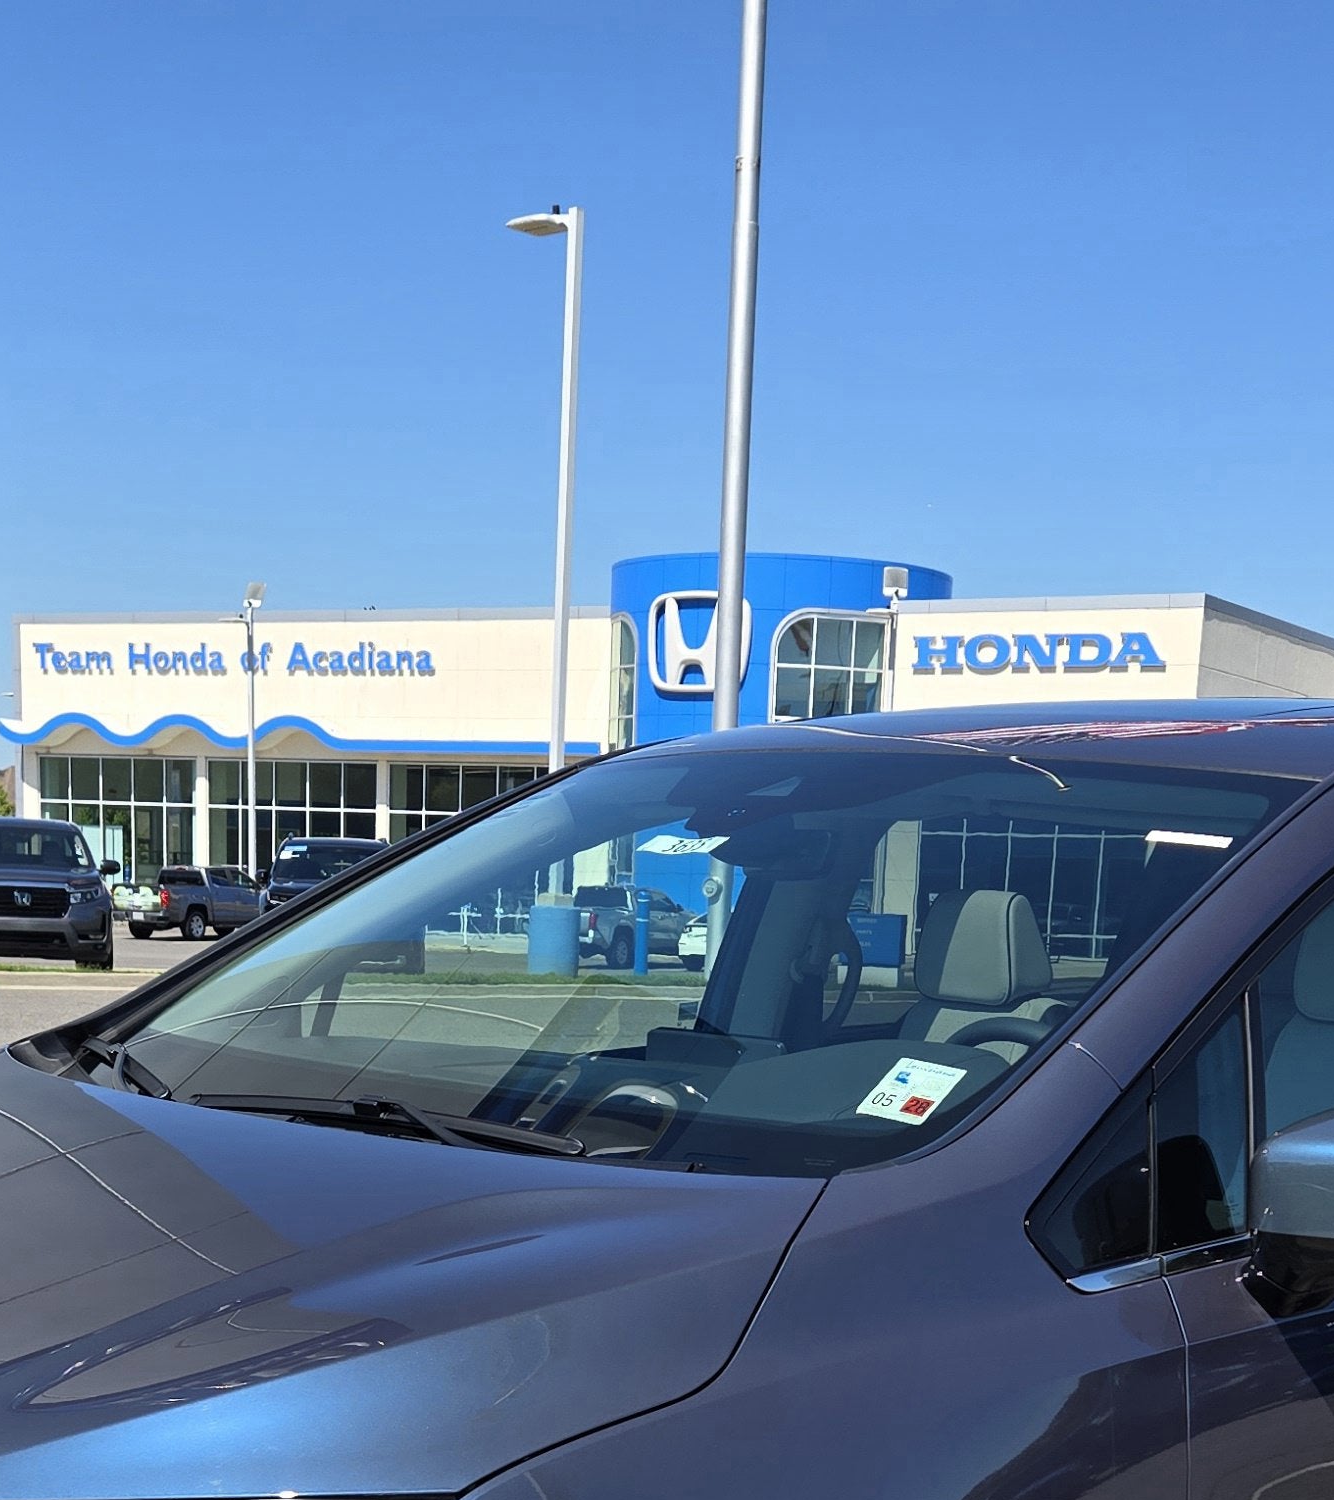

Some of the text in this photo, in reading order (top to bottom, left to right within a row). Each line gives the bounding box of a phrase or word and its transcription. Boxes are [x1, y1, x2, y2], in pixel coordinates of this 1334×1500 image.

[32, 641, 436, 676] Team Honda of Acadiana
[912, 632, 1167, 674] HONDA
[871, 1092, 931, 1114] 05 28
